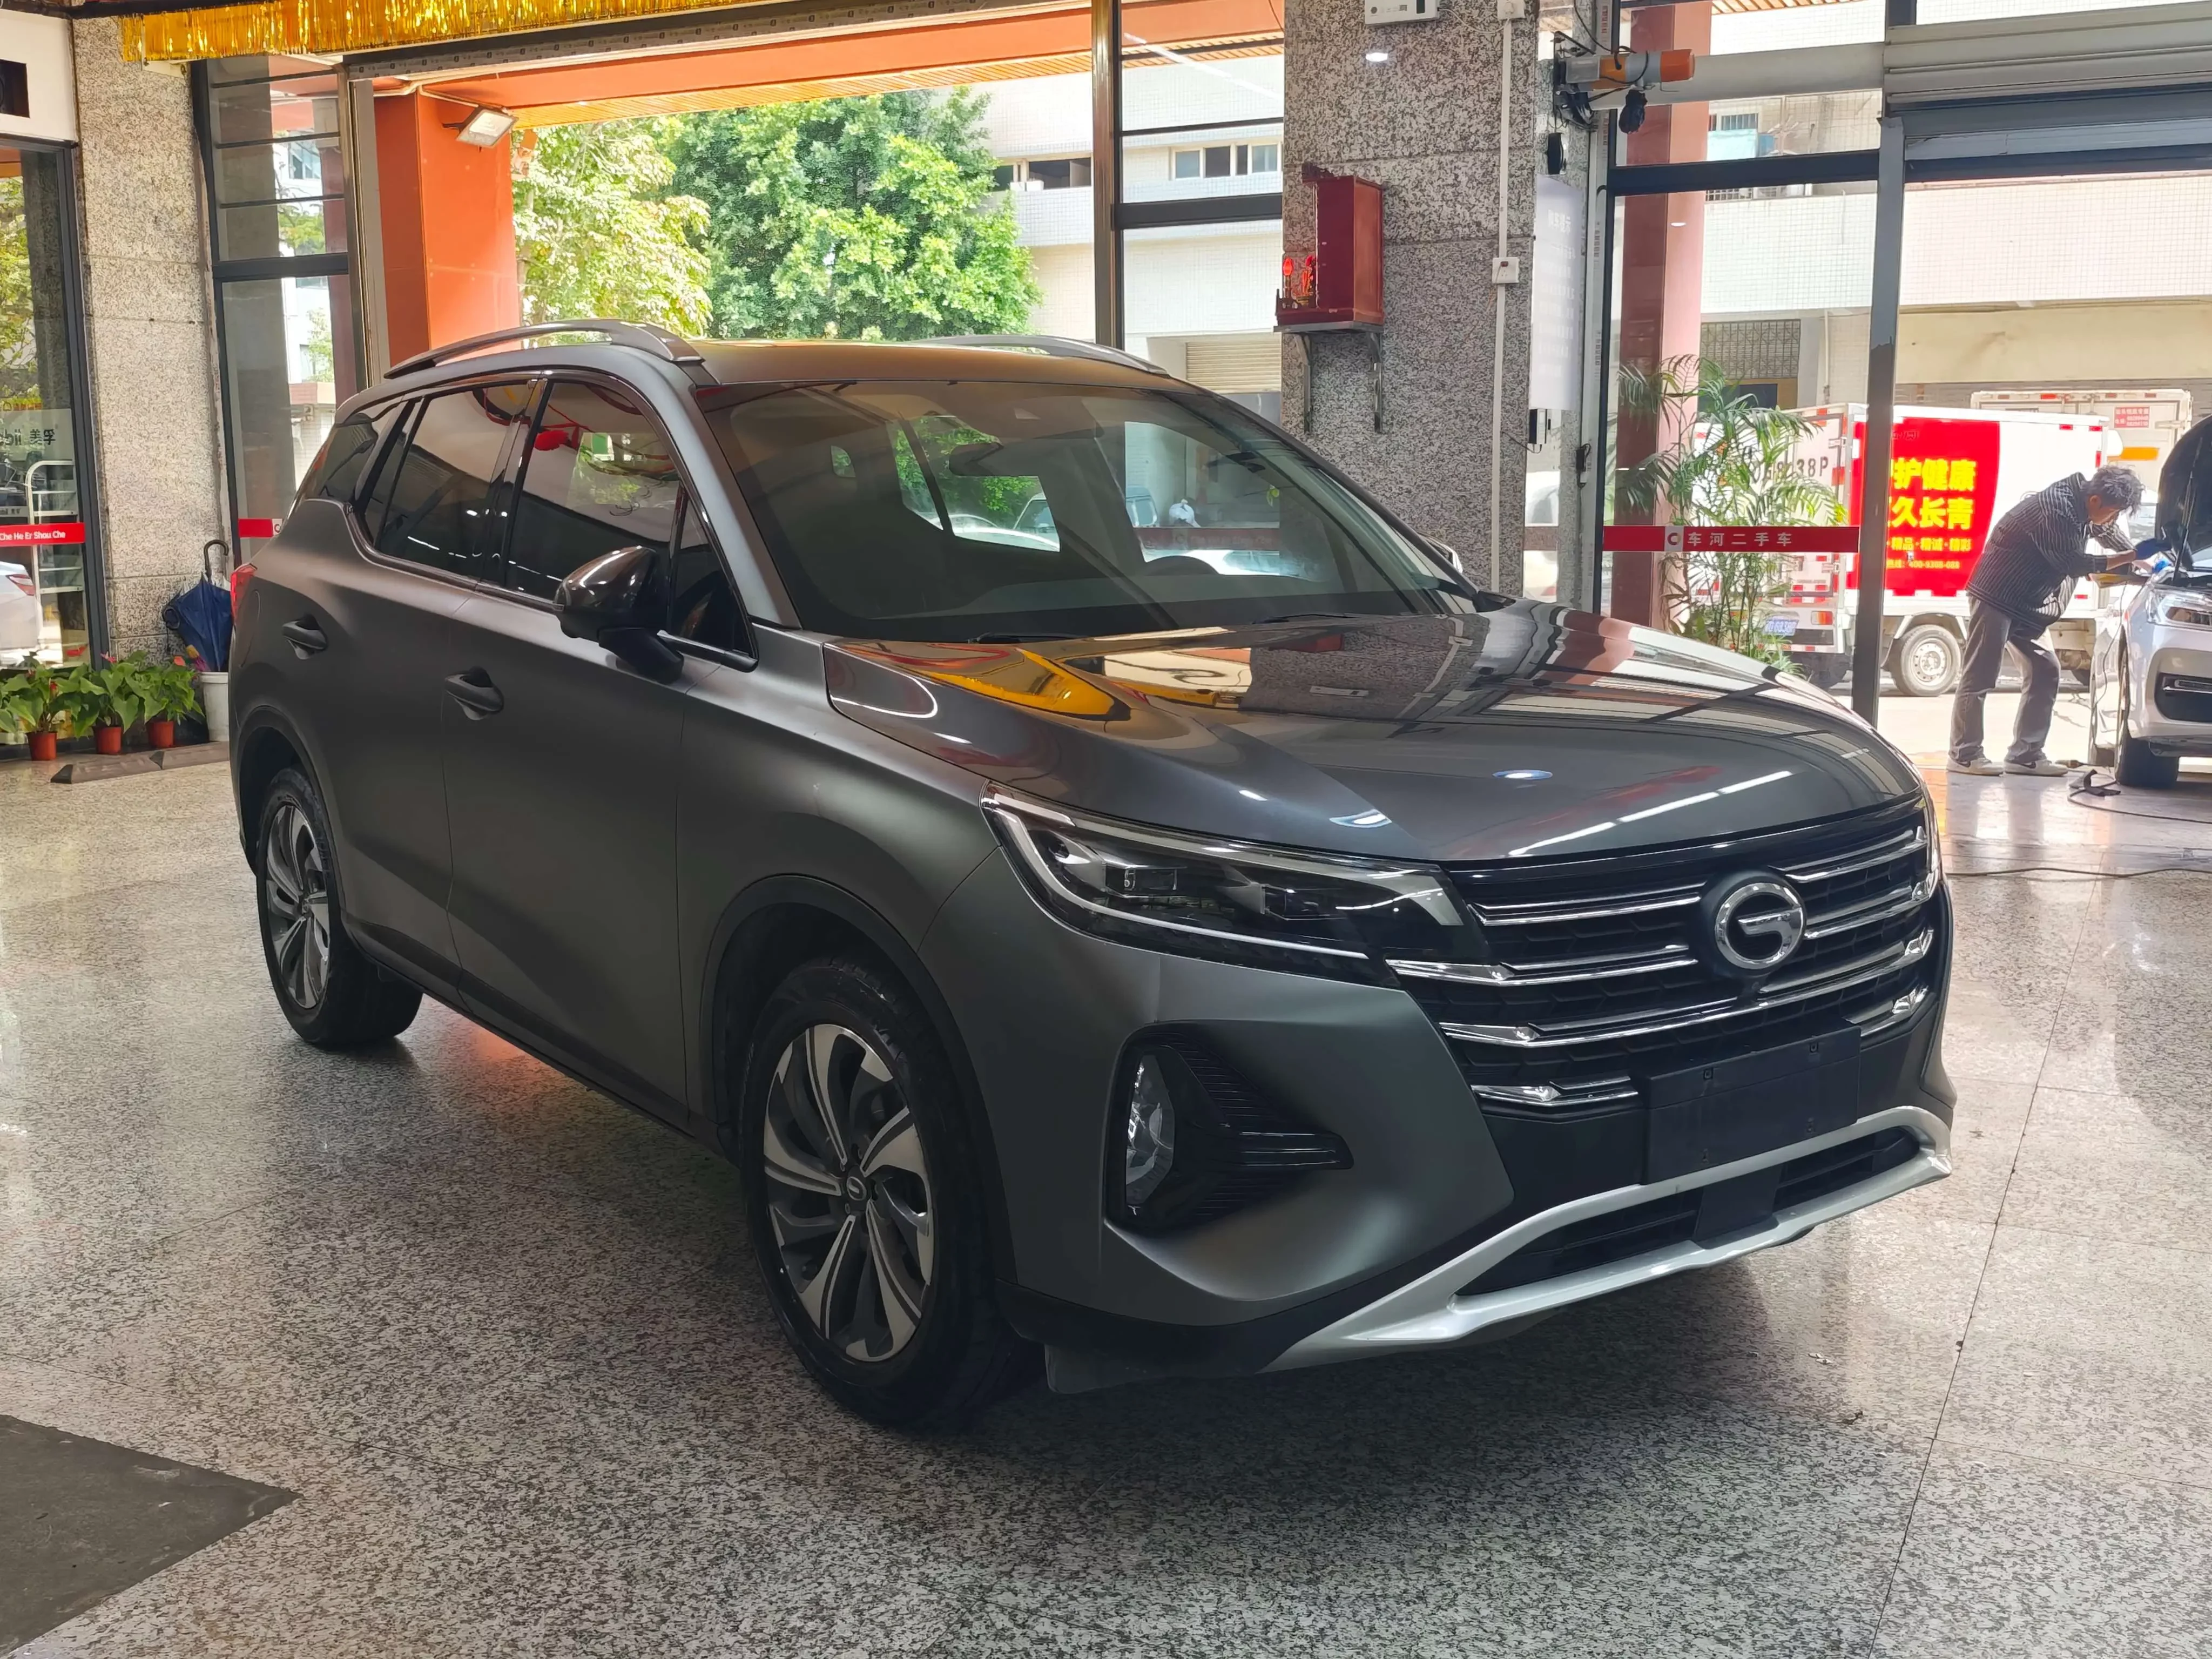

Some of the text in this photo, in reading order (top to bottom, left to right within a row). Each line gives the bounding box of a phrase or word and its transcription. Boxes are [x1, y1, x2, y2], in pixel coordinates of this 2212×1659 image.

[30, 429, 56, 446] 美孚
[1890, 457, 1977, 492] 护健康
[1889, 496, 1974, 530] 久长青
[0, 530, 66, 541] Che He Er Shou Che
[1687, 531, 1792, 547] 车河二手车
